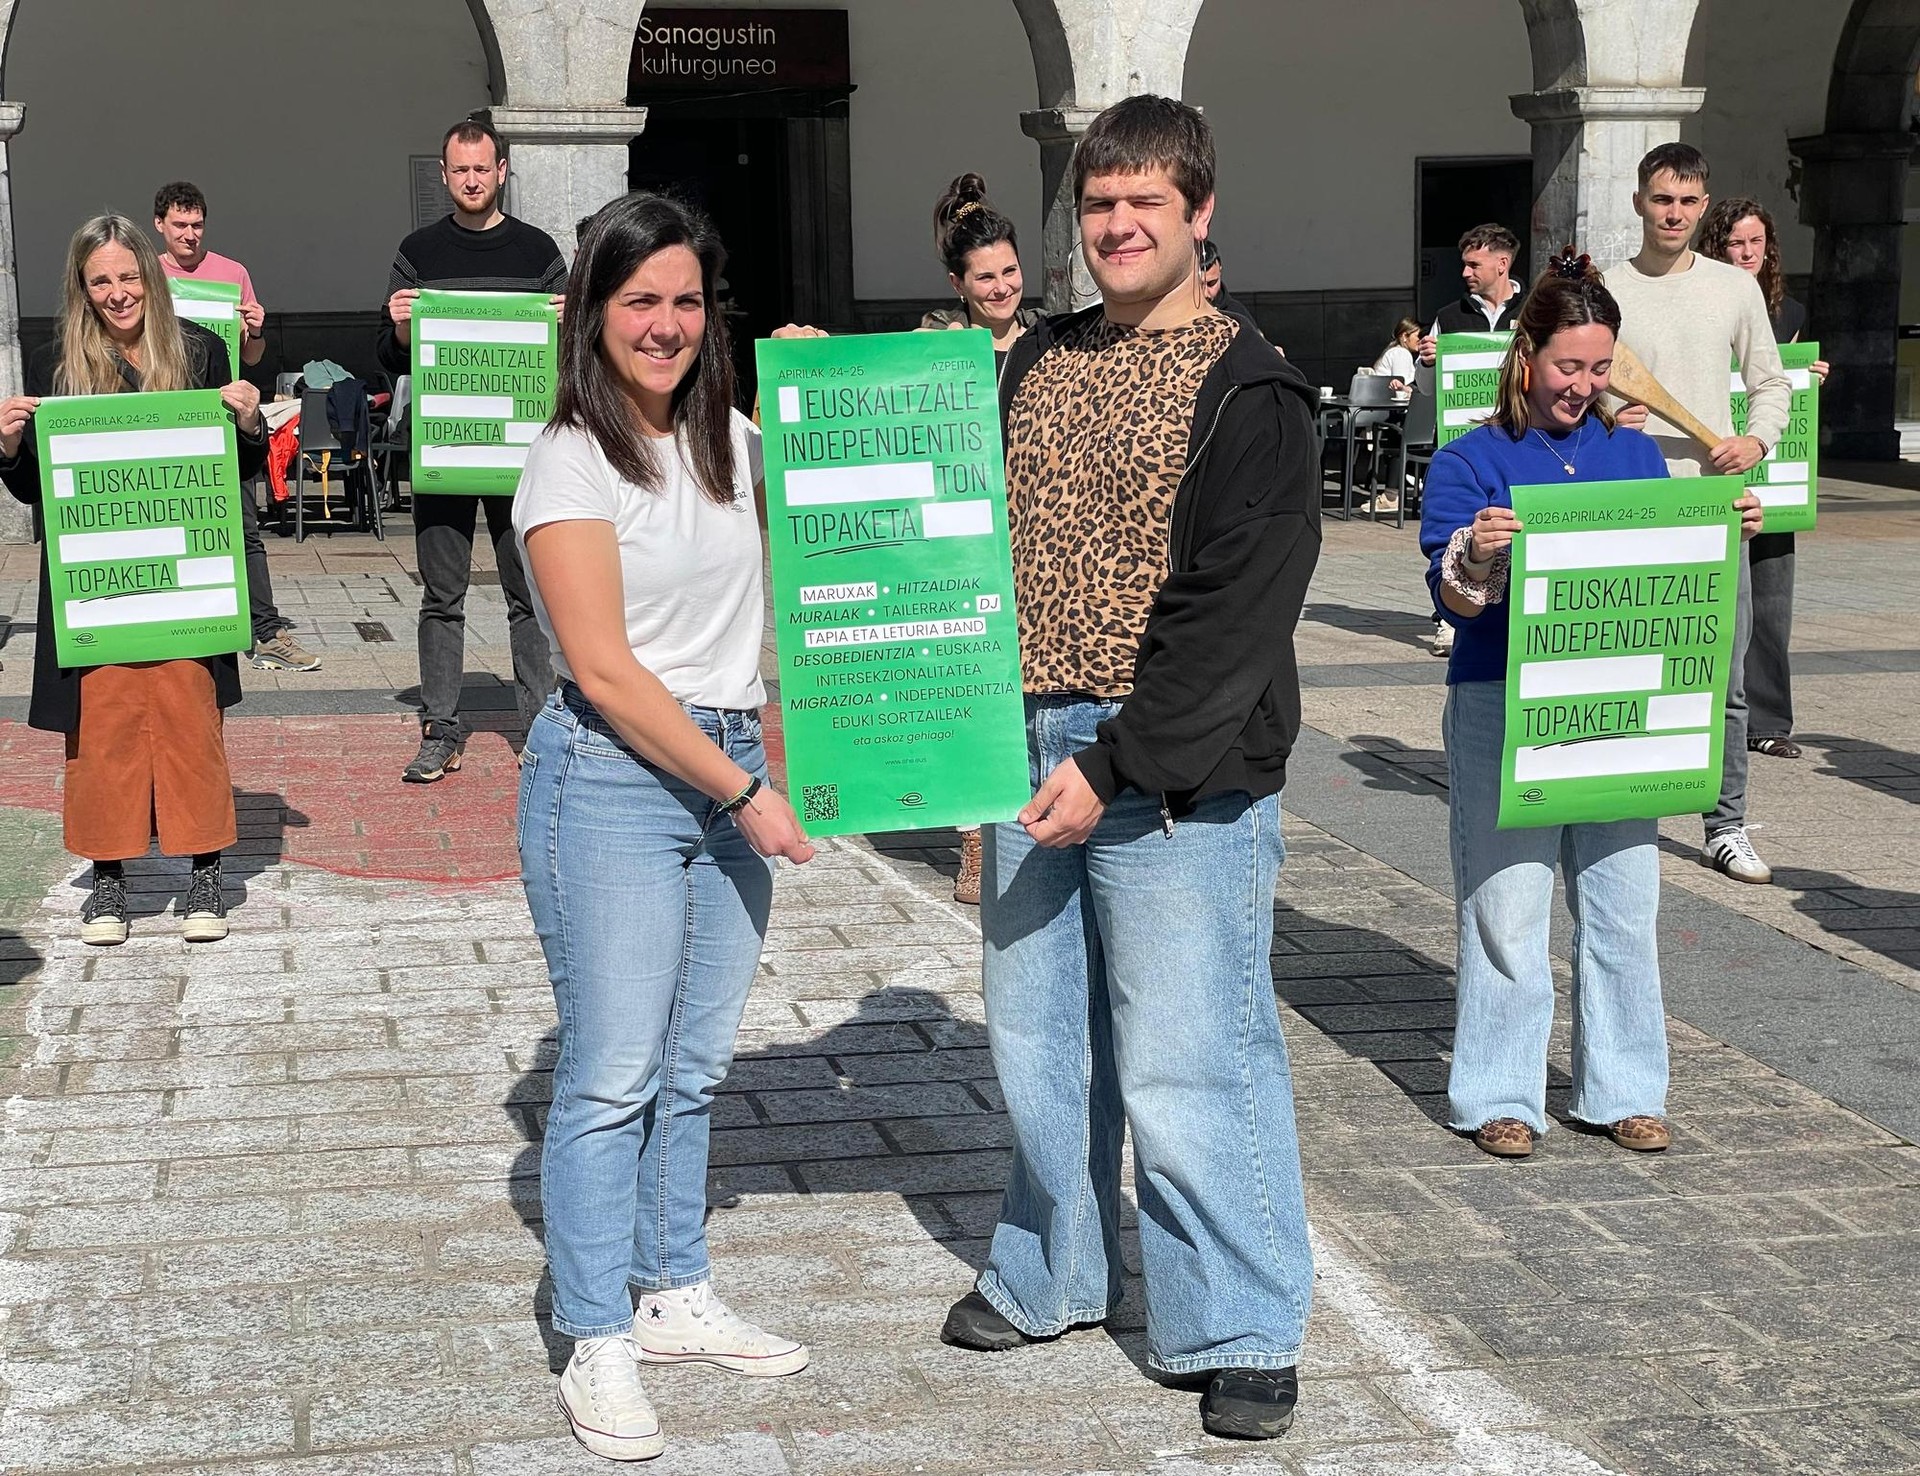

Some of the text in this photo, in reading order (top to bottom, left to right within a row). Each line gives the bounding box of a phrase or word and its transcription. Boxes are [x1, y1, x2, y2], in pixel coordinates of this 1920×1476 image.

[638, 17, 776, 50] Sanagustin
[641, 48, 776, 81] kulturgunea
[420, 306, 547, 318] 2026 APIRILAK 24-25 AZPEITIA
[439, 347, 546, 369] EUSKALTZALE
[778, 360, 976, 380] APIRILAK 24-25 AZPEITIA
[423, 372, 546, 394] INDEPENDENTIS
[1455, 373, 1500, 389] EUSKAL
[517, 399, 547, 418] TON
[805, 381, 980, 420] EUSKALTZALE
[1444, 391, 1498, 407] INDEPEN
[49, 411, 221, 429] 2026 APIRILAK 24-25 AZPEITIA
[423, 421, 502, 442] TOPAKETA
[783, 421, 983, 463] INDEPENDENTIS
[1778, 441, 1808, 459] TON
[79, 463, 225, 495] EUSKALTZALE
[936, 463, 987, 494] TON
[59, 495, 228, 529] INDEPENDENTIS
[1527, 505, 1727, 525] 2026 APIRILAK 24-25 AZPEITIA
[787, 508, 917, 545] TOPAKETA
[189, 527, 230, 552] TON
[65, 563, 173, 594] TOPAKETA
[803, 577, 981, 602] MARUXAK HITZALDIAK
[1553, 572, 1721, 611] EUSKALTZALE
[789, 598, 999, 625] MURALAK TAILERRAK DJ
[170, 624, 238, 636] www.ehe.eus
[807, 620, 984, 645] TAPIA ETA LETURIA BAND
[1526, 614, 1719, 655] INDEPENDENTIS
[793, 640, 1002, 667] DESOBEDIENTZIA EUSKARA
[816, 663, 982, 687] INTERSEKZIONALITATEA
[1669, 655, 1715, 687] TON
[790, 682, 1015, 711] MIGRAZIOA INDEPENDENTZIA
[832, 706, 973, 729] EDUKI SORTZAILEAK
[1522, 700, 1640, 738] TOPAKETA
[853, 729, 955, 746] eta askoz gehiago!
[1629, 779, 1706, 794] www.ehe.eus
